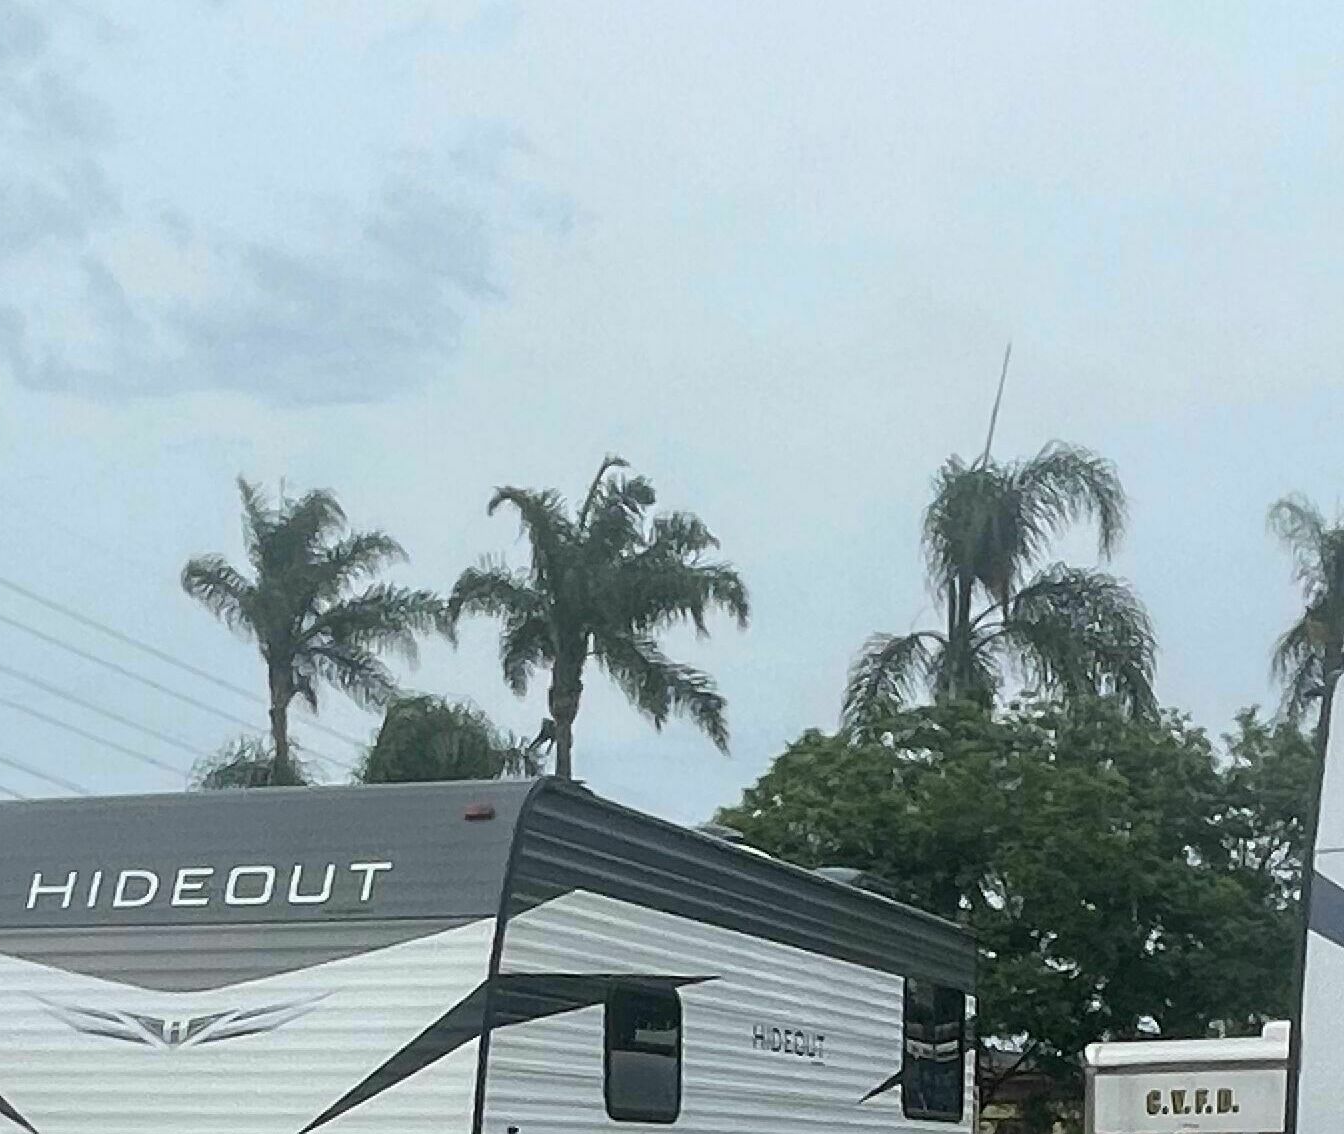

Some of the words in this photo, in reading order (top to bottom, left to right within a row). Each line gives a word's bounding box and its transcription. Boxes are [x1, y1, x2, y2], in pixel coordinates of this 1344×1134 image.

[26, 862, 393, 909] HIDEOUT
[752, 1025, 825, 1058] HIDEOUT
[1146, 1088, 1240, 1116] C.V.F.D.
